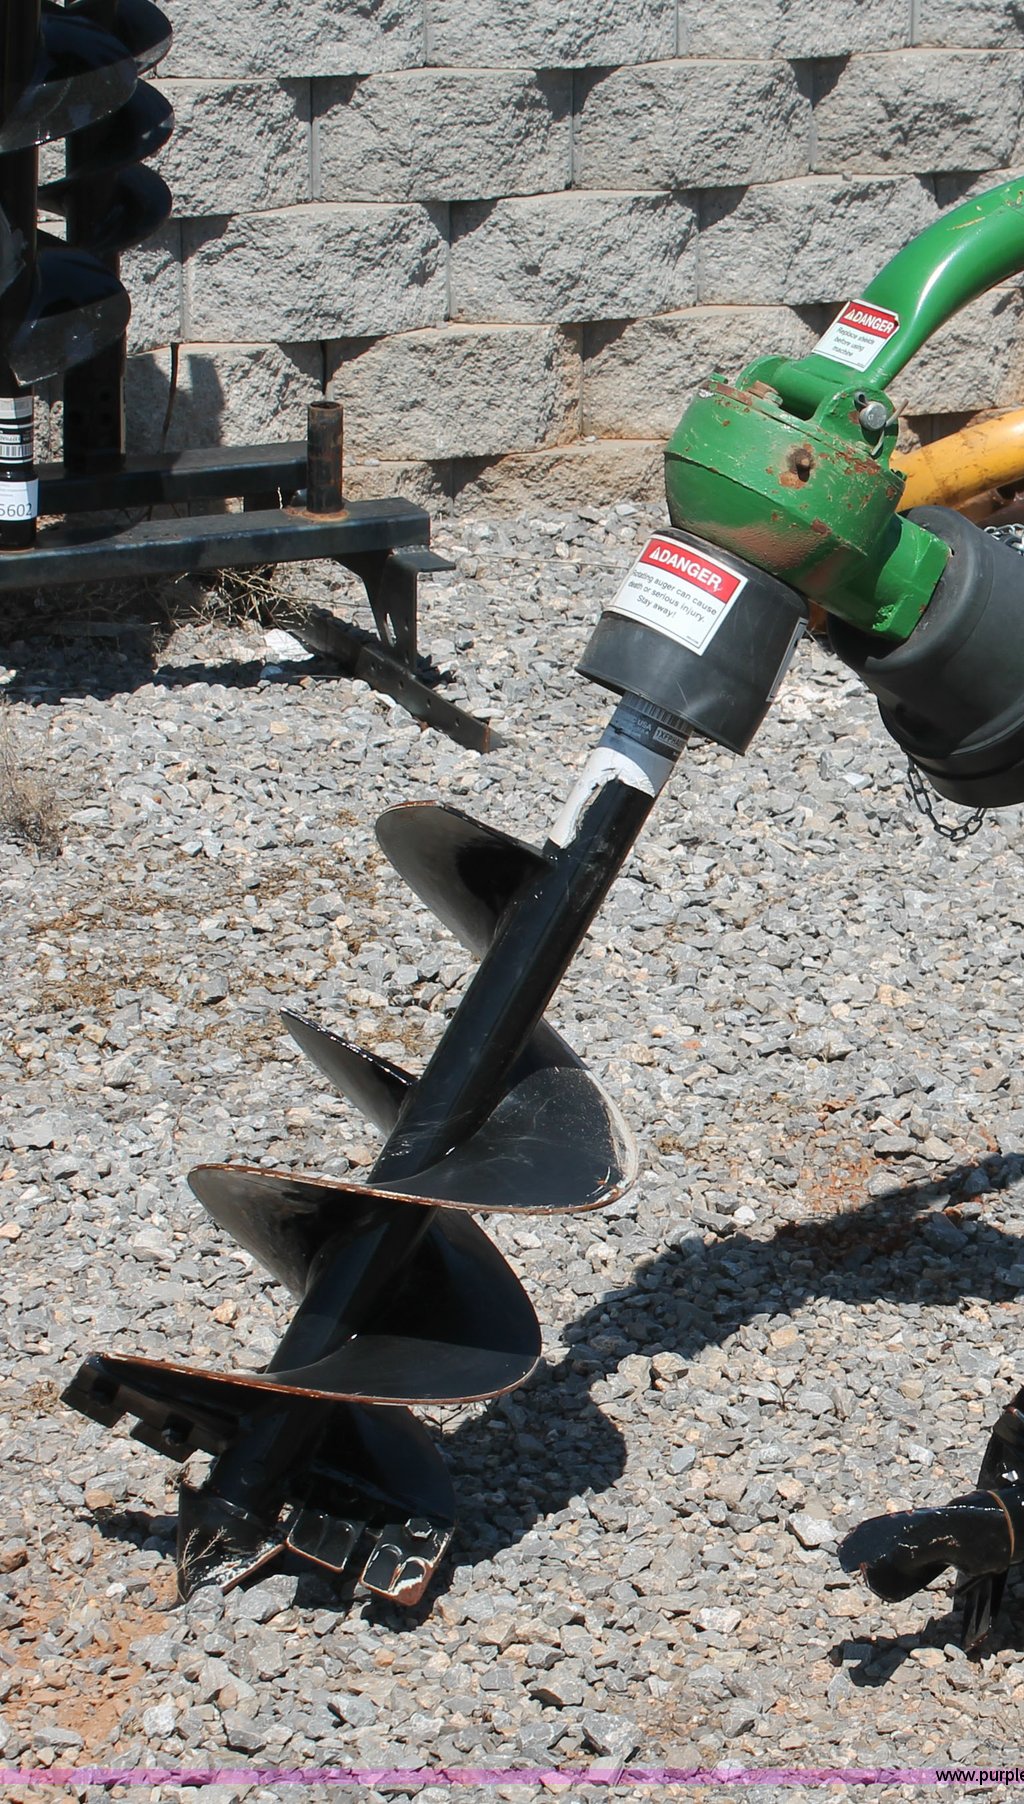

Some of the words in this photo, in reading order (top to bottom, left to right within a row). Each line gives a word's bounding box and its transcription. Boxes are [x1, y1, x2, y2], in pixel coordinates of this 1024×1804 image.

[854, 311, 894, 333] DANGER
[657, 549, 722, 591] DANGER
[628, 581, 643, 592] death
[651, 589, 679, 607] serious
[680, 604, 705, 623] injury.
[636, 594, 653, 609] Stay
[652, 603, 677, 618] away!
[654, 578, 676, 592] auger
[676, 588, 691, 600] can
[692, 597, 717, 615] cause
